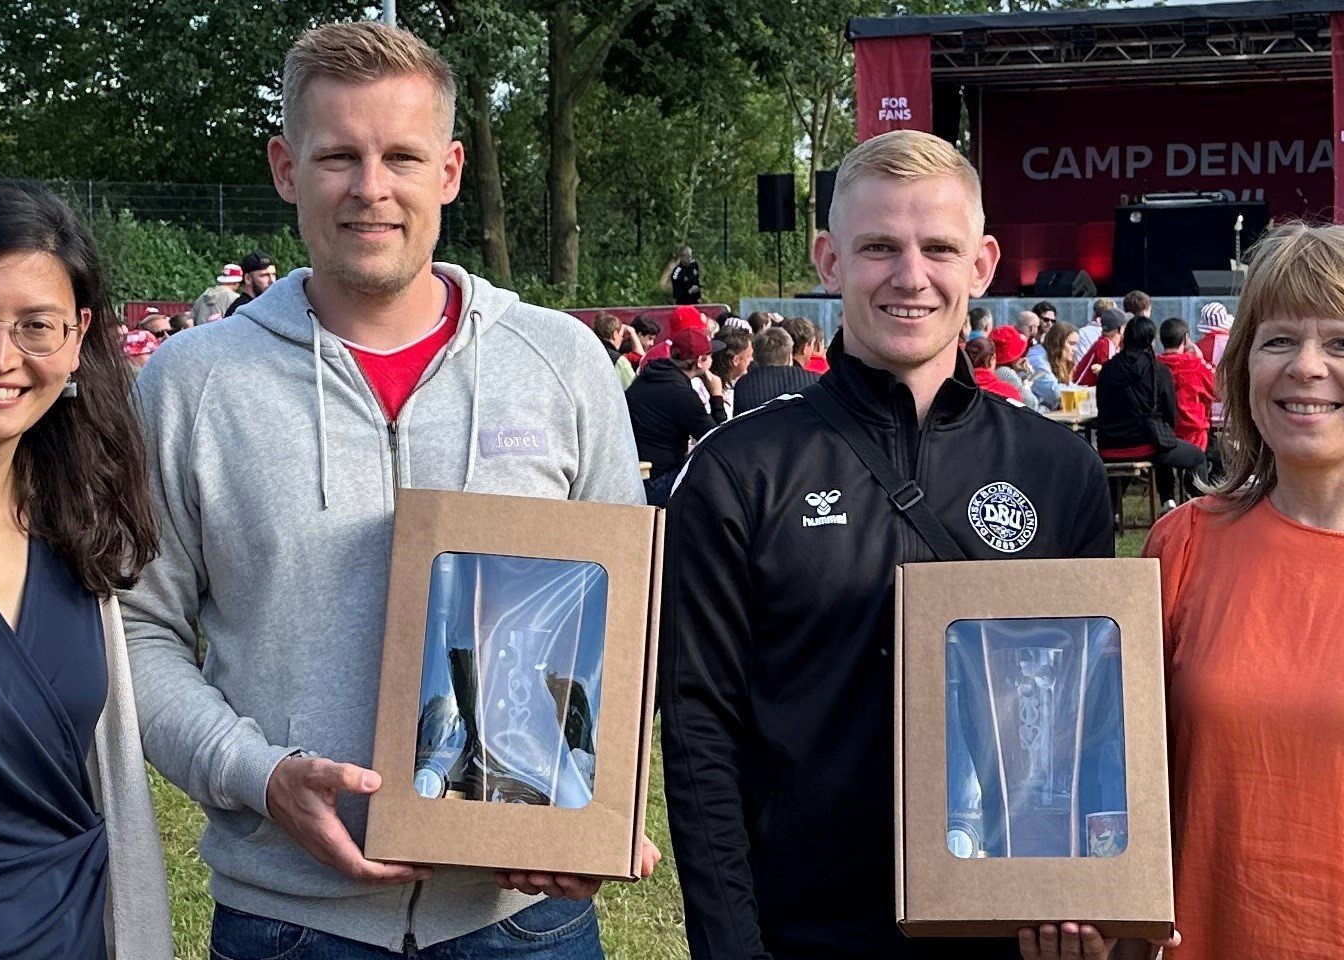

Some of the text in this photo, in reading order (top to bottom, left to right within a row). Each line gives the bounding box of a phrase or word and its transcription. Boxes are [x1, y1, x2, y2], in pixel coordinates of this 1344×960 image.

[881, 97, 908, 108] FOR
[878, 109, 912, 121] FANS
[1022, 146, 1152, 180] CAMP
[983, 503, 1022, 530] DBU
